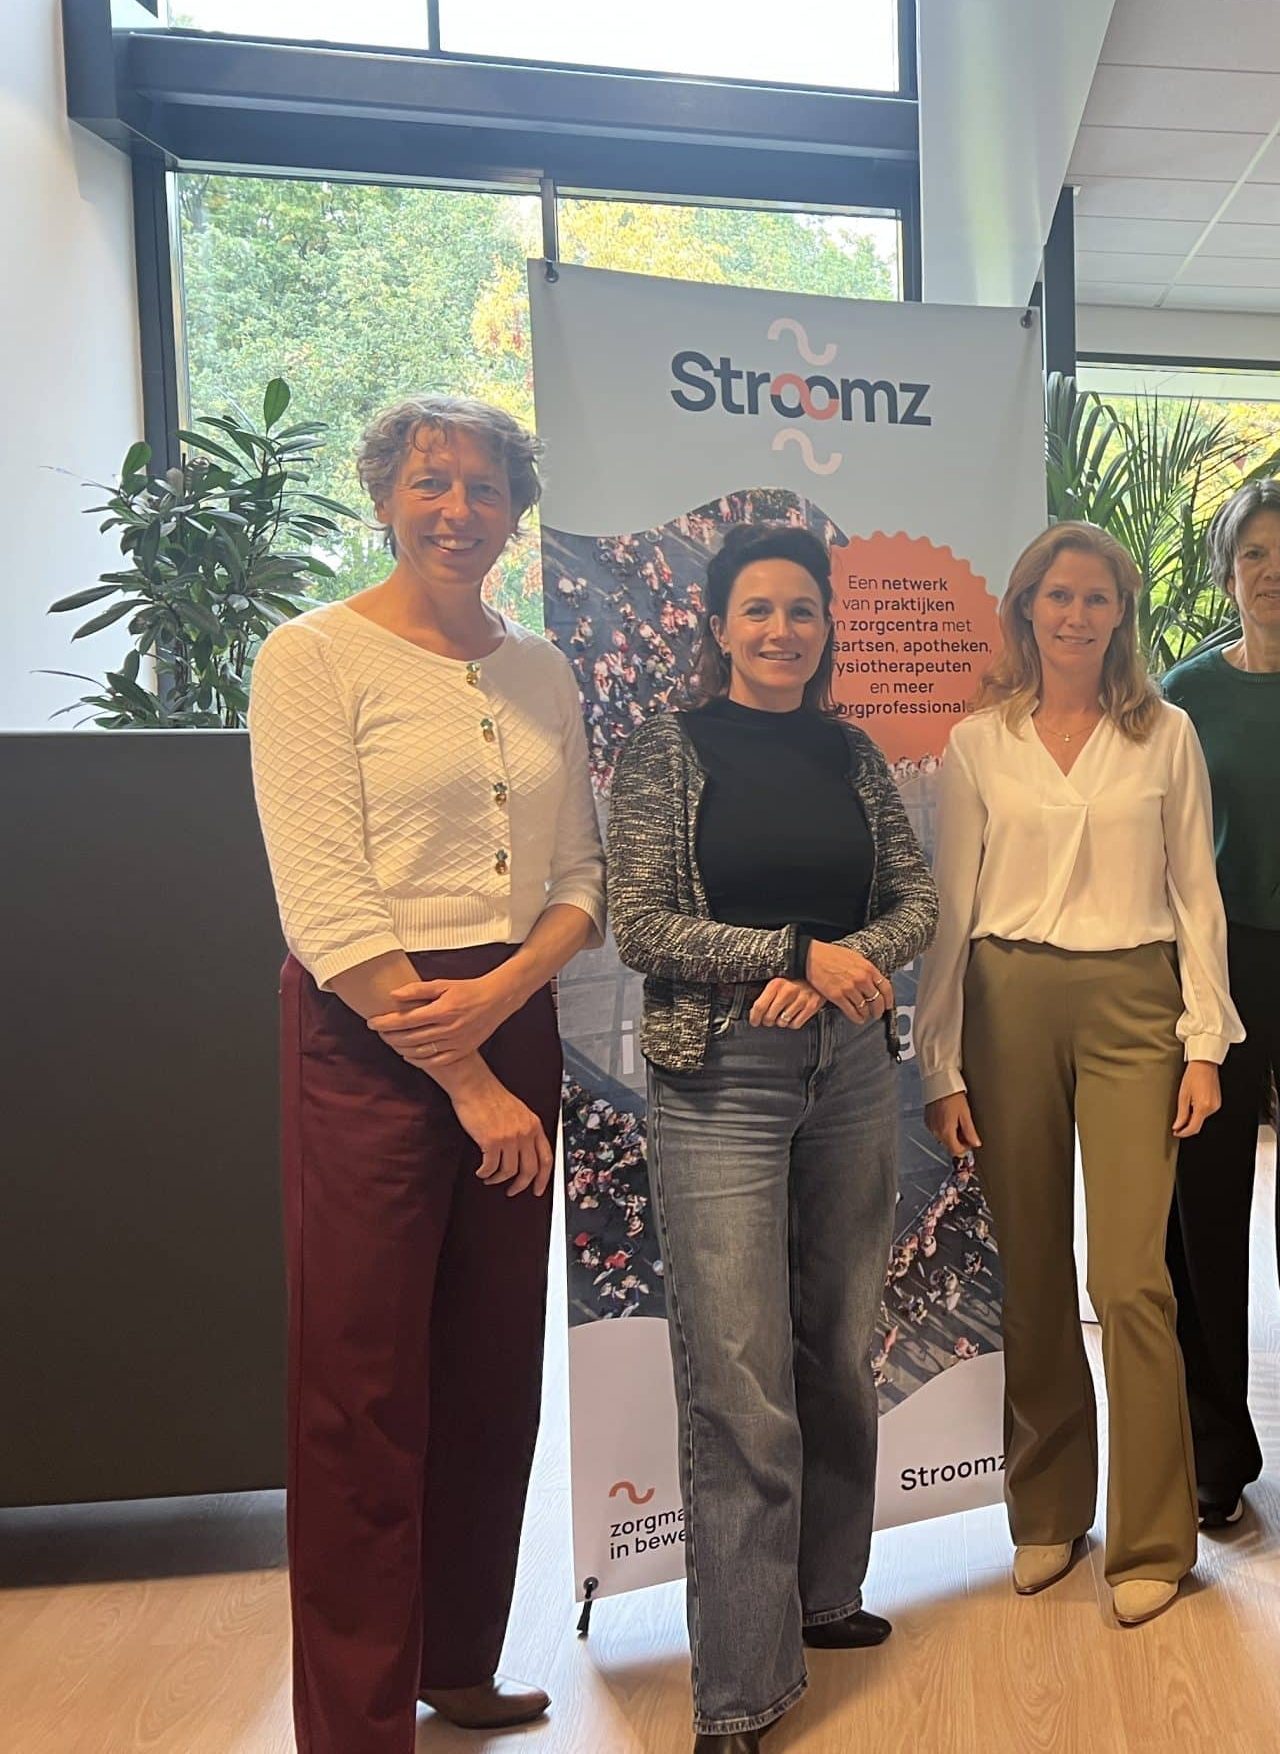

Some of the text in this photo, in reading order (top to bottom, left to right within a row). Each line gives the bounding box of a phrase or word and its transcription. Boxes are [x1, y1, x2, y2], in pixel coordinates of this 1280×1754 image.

[670, 350, 932, 426] Stroomz
[848, 575, 949, 592] Een netwerk
[842, 598, 955, 614] van praktijken
[834, 619, 973, 635] n zorgcentra met
[832, 638, 993, 656] sartsen, apotheken,
[835, 659, 972, 676] ysiotherapeuten
[870, 682, 935, 694] en meer
[610, 1508, 686, 1538] zorgma
[610, 1528, 687, 1560] in bewe
